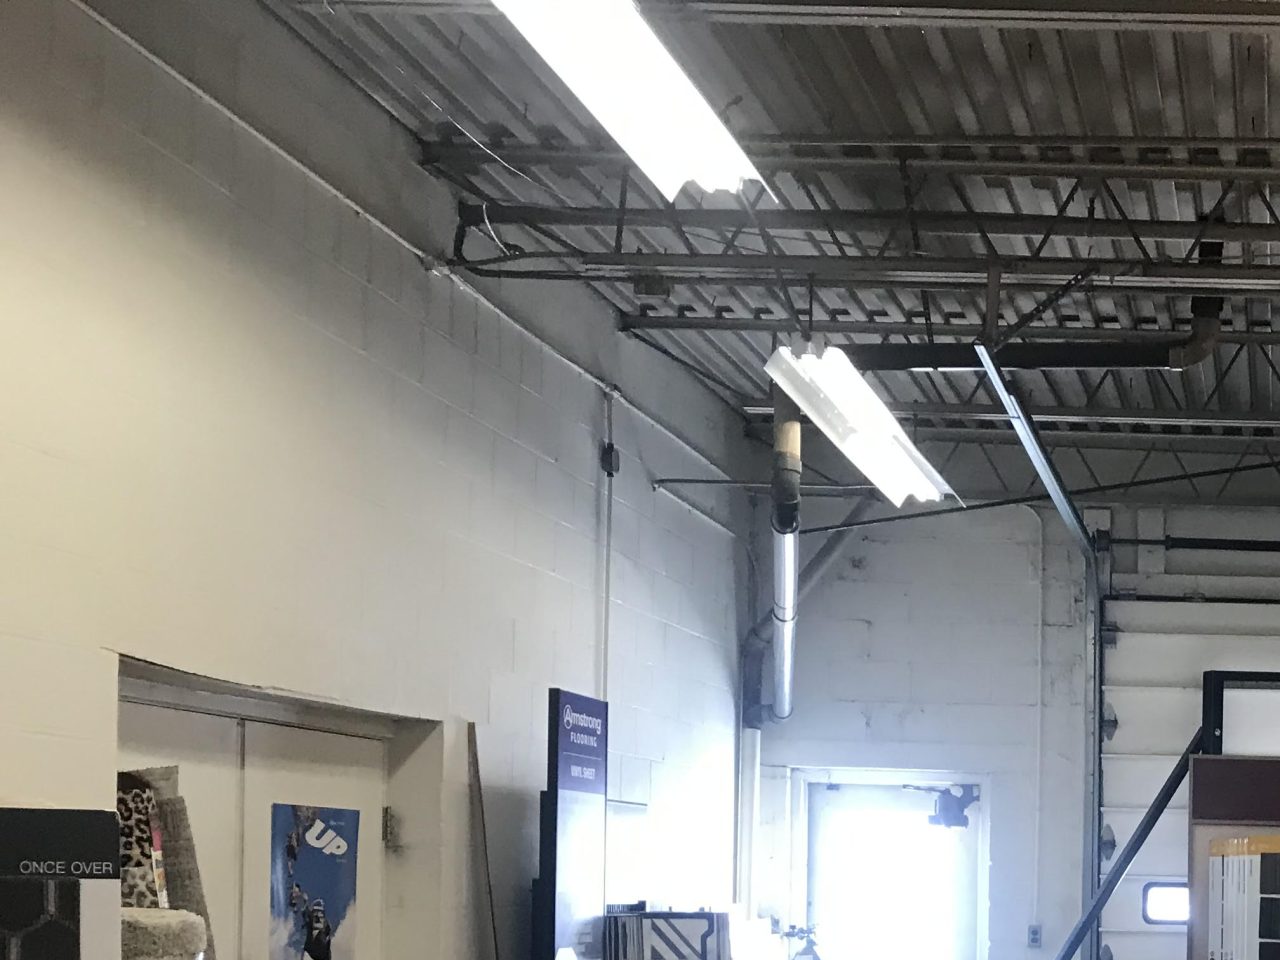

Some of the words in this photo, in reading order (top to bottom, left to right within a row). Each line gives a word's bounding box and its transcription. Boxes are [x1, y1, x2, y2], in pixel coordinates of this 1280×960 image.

[563, 704, 602, 735] Armstrong
[570, 731, 598, 747] FLOORING
[583, 766, 596, 780] SHEET
[305, 818, 348, 855] UP
[19, 860, 67, 874] ONCE
[70, 861, 113, 874] OVER
